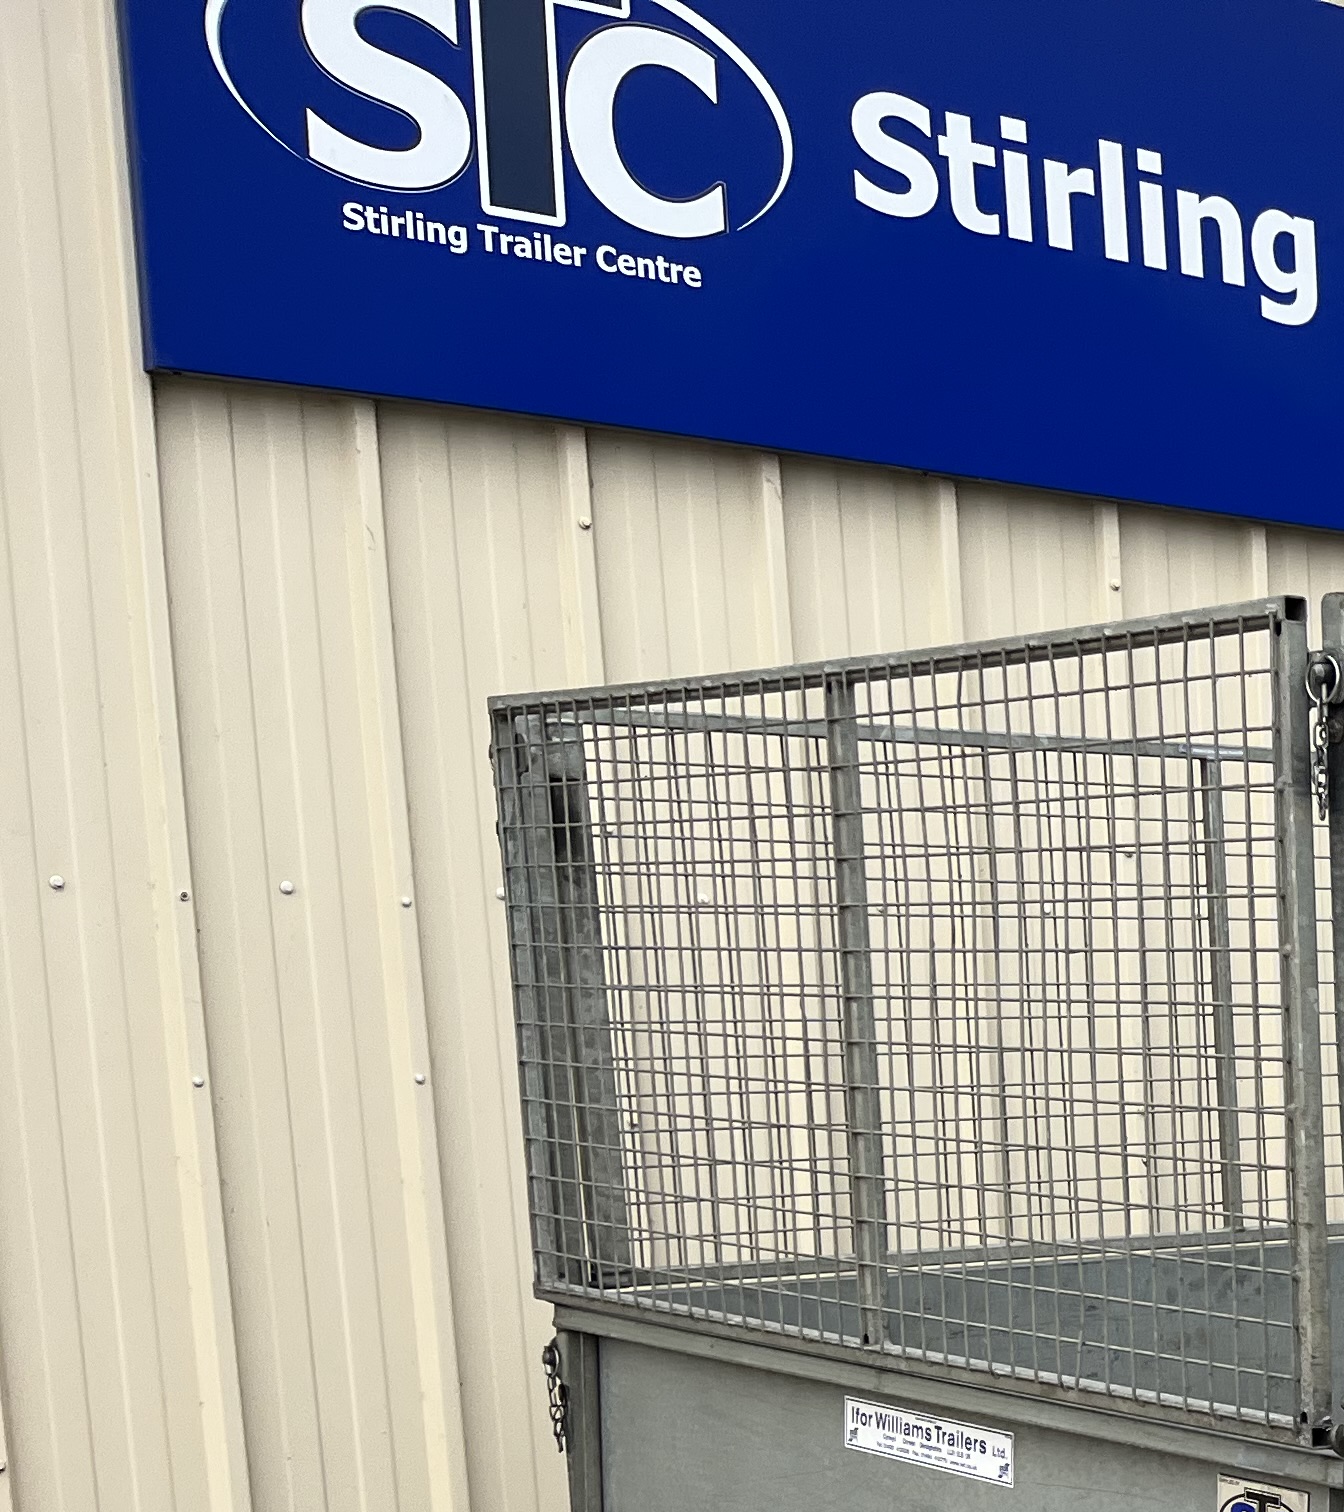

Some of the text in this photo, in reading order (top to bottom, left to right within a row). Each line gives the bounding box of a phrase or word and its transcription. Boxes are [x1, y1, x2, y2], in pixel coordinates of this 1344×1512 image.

[300, 0, 728, 239] STC
[342, 201, 703, 288] Stirling Trailer Centre
[851, 91, 1318, 326] Stirling
[851, 1405, 873, 1428] Ifor
[874, 1411, 932, 1442] Williams
[934, 1425, 987, 1455] Trailers
